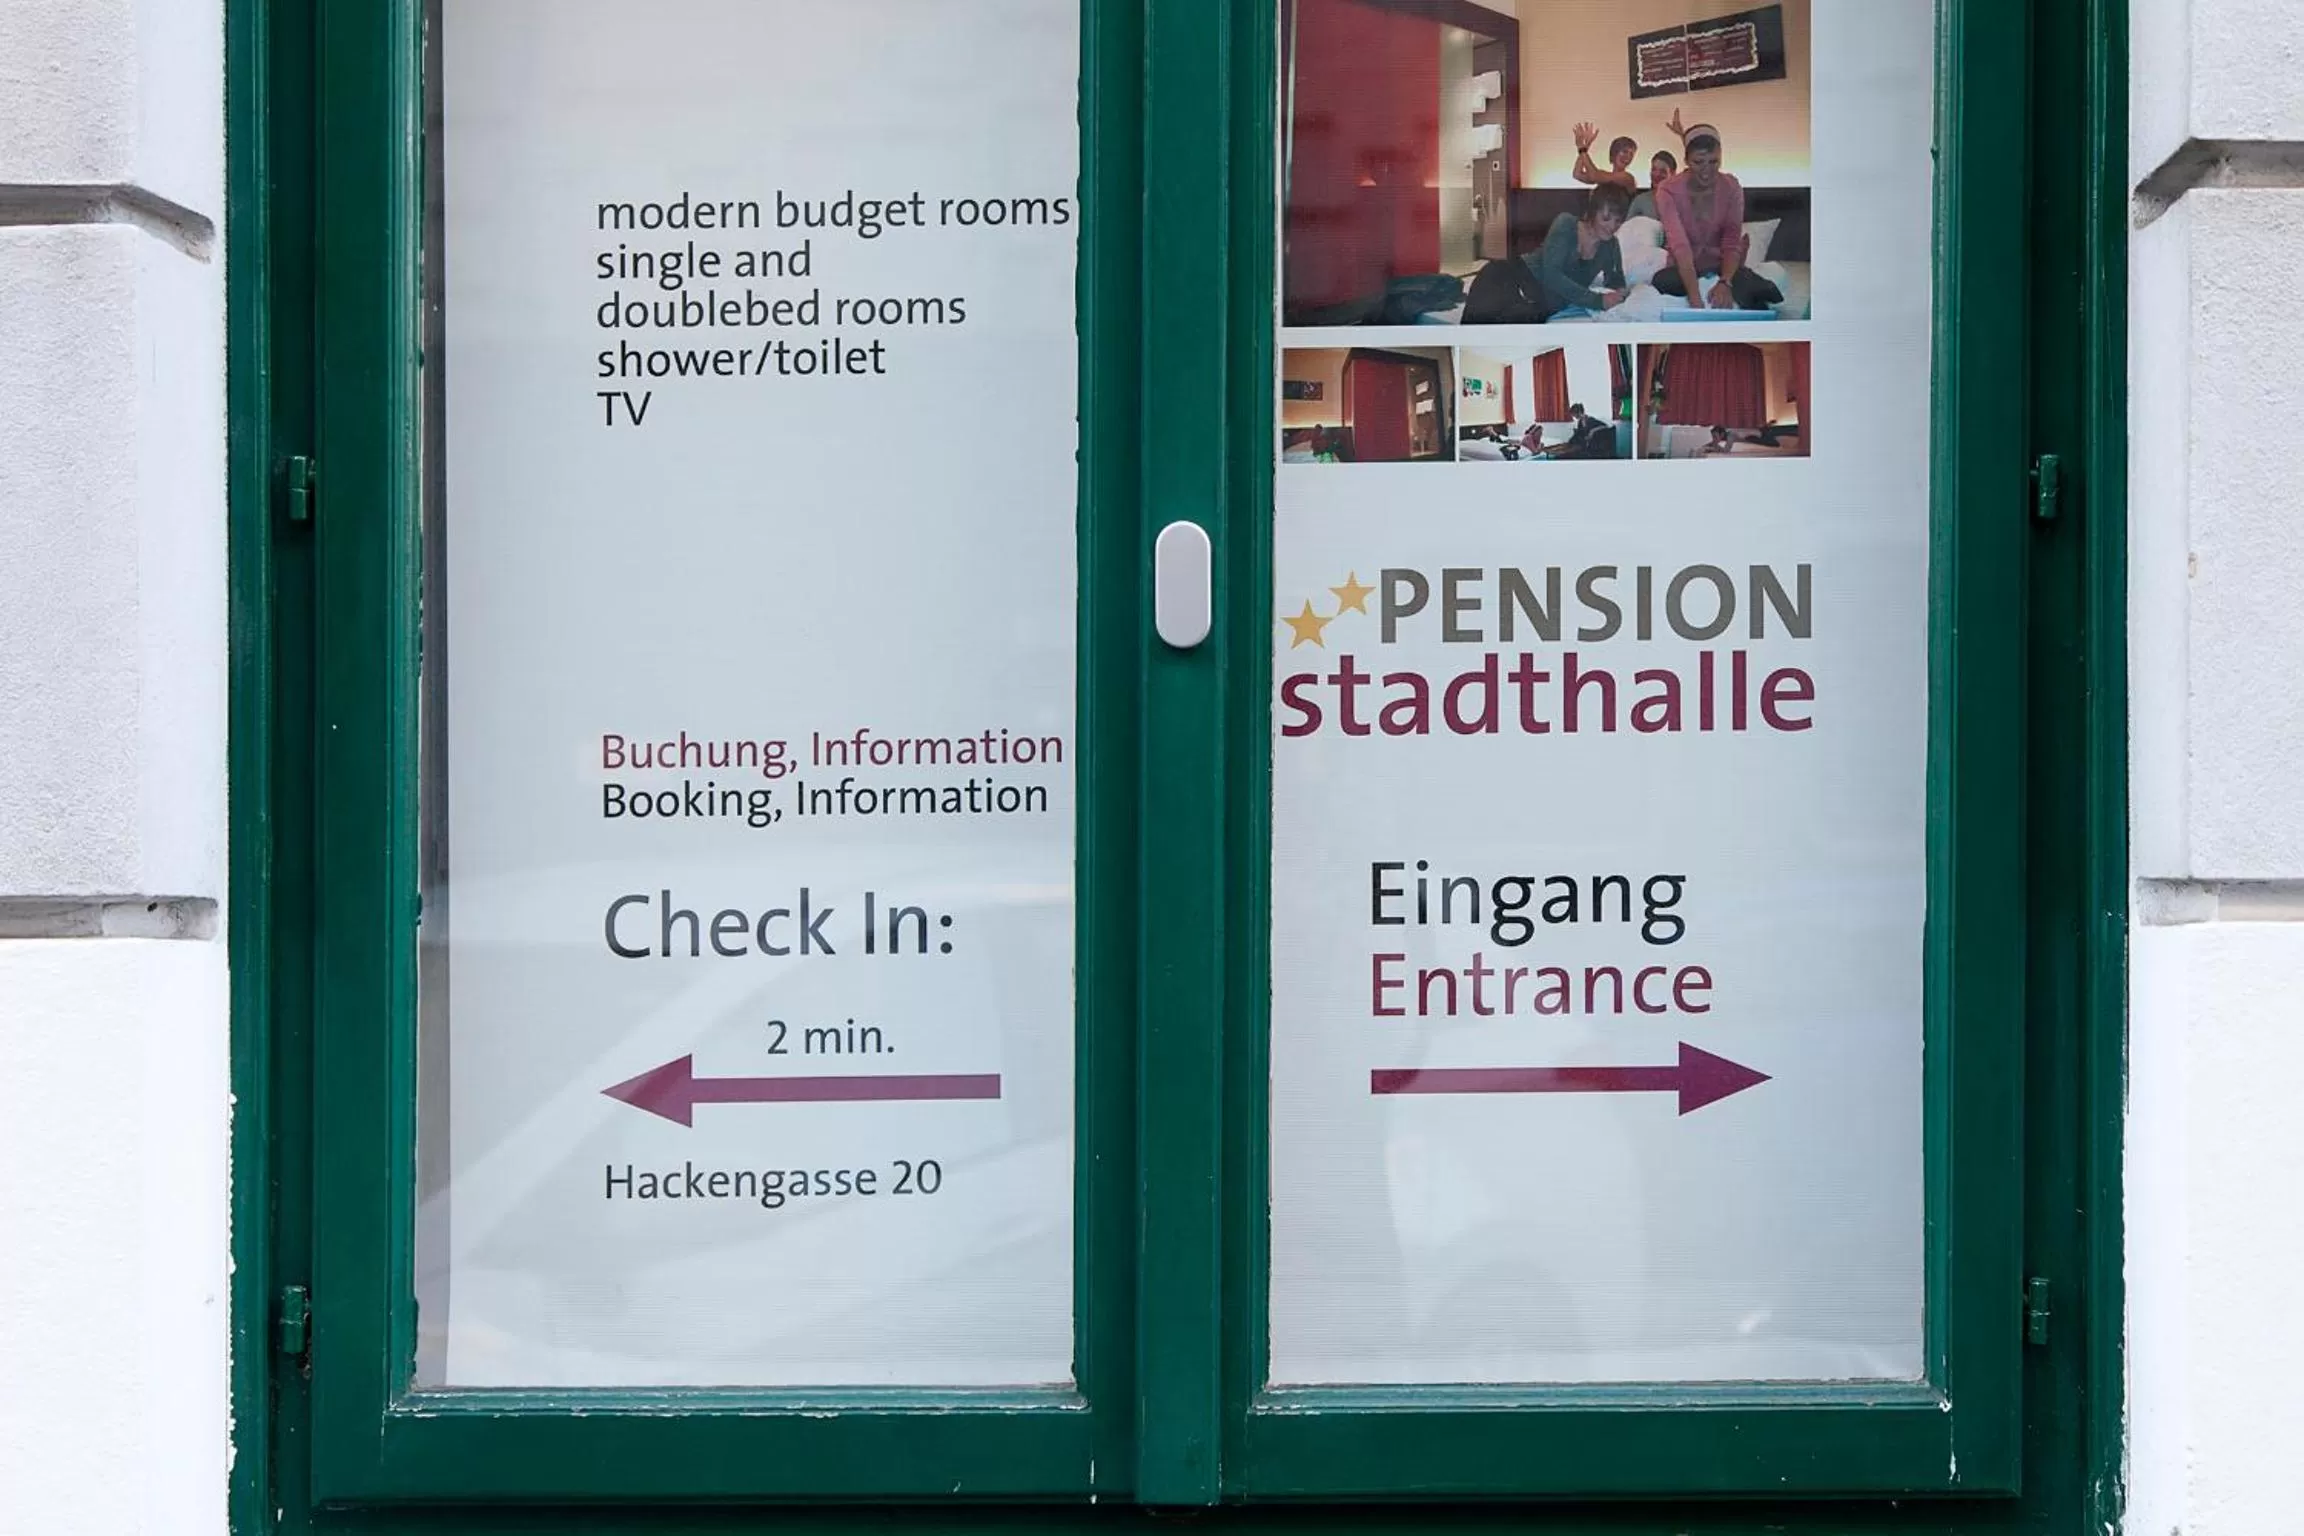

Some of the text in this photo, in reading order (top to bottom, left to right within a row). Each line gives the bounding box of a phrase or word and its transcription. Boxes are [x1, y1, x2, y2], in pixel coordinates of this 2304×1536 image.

[598, 190, 1069, 239] modern budget rooms
[597, 239, 810, 291] single and
[597, 288, 966, 328] doublebed rooms
[598, 337, 886, 377] shower/toilet
[597, 391, 652, 426] TV
[1381, 564, 1811, 643] PENSION
[1281, 650, 1815, 737] stadthalle
[603, 728, 1062, 779] Buchung, Information
[603, 777, 1047, 828] Booking, Information
[605, 888, 953, 959] Check In:
[1372, 860, 1686, 947] Eingang
[1373, 952, 1712, 1016] Entrance
[768, 1018, 894, 1054] 2 min.
[606, 1160, 942, 1209] Hackengasse 20
